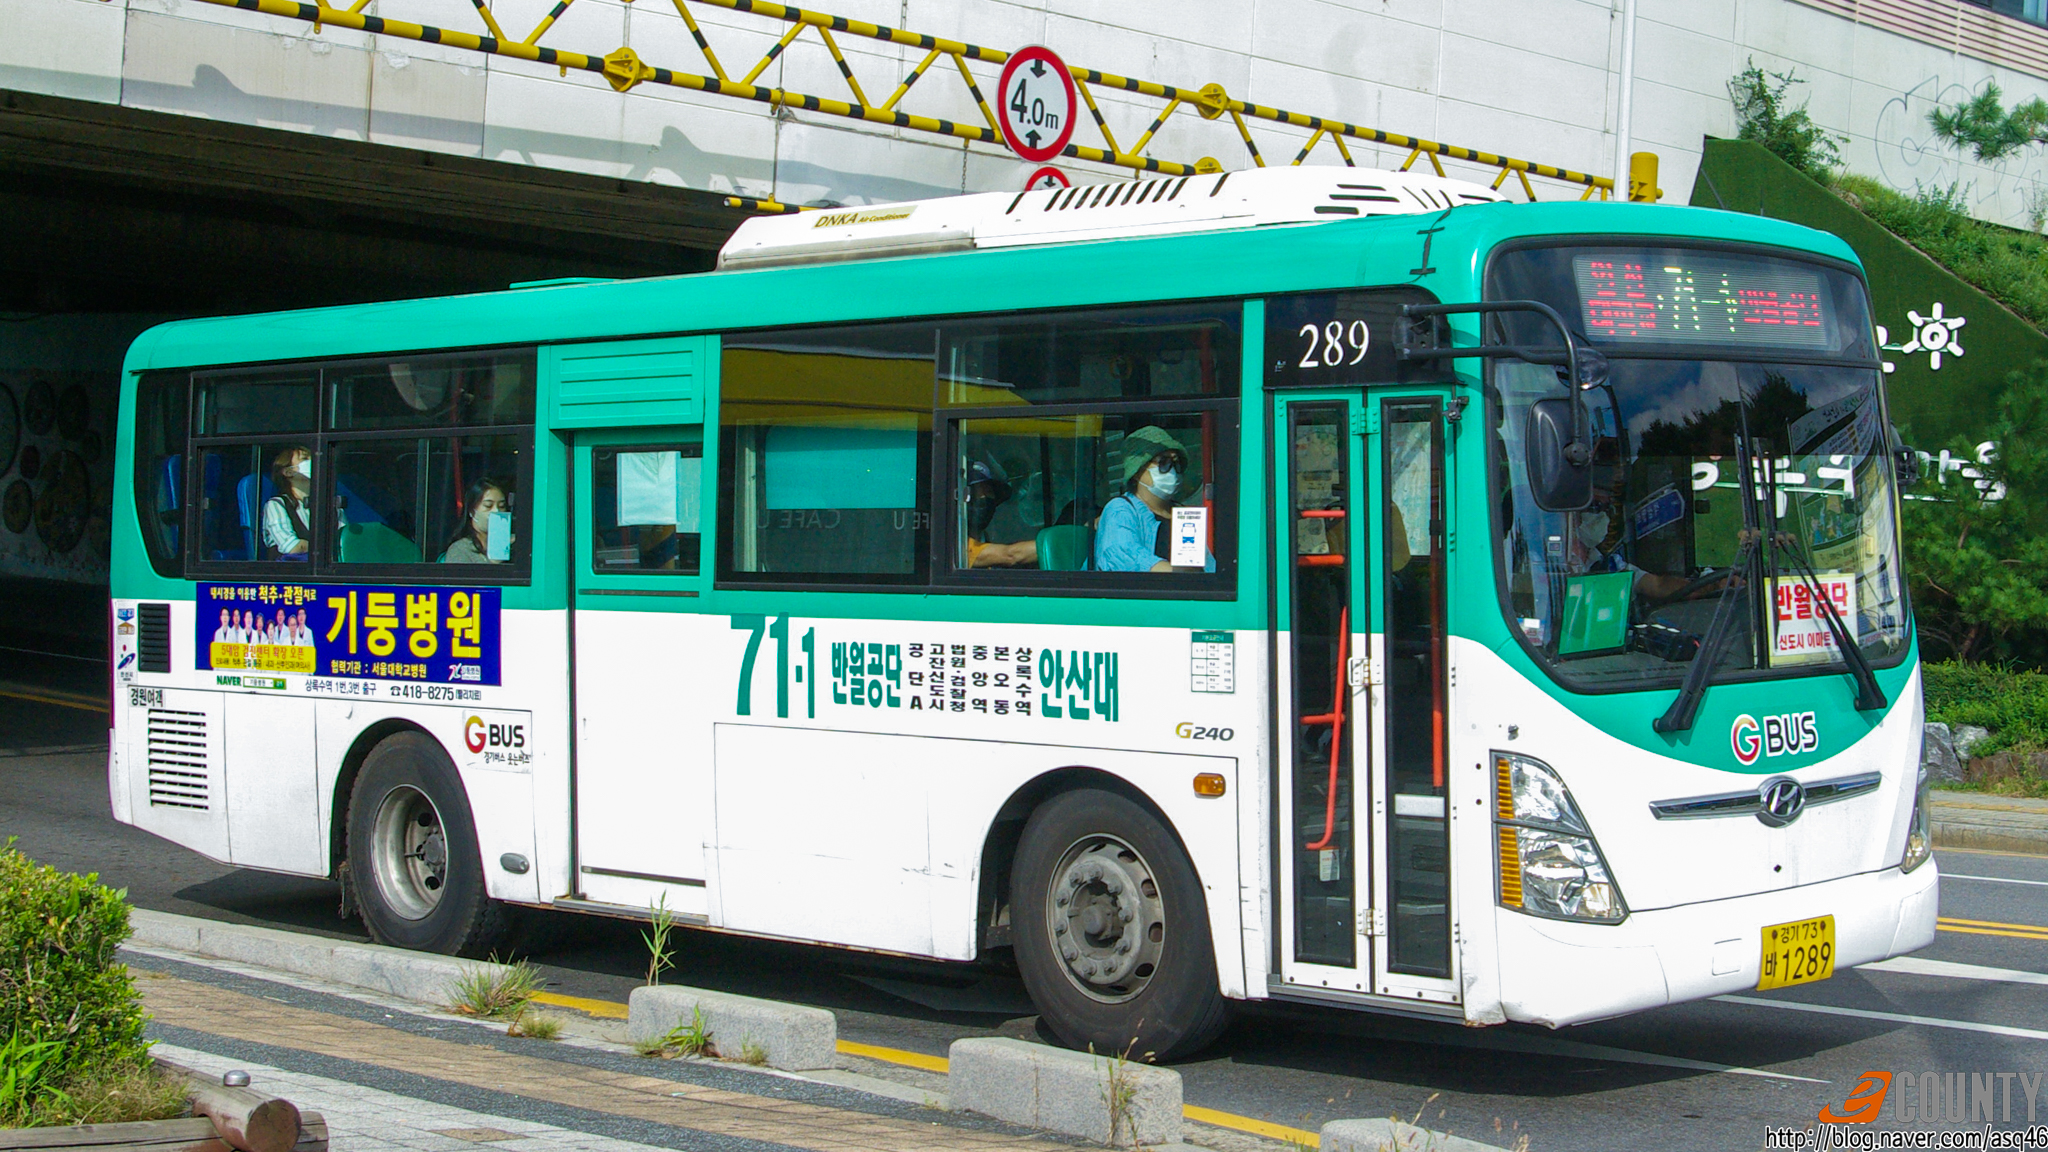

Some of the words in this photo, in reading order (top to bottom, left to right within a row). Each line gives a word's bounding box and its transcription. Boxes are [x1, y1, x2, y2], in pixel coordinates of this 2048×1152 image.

[1010, 78, 1059, 130] 4.0m
[814, 212, 859, 228] DNKA
[869, 213, 911, 222] Conditioner
[1298, 319, 1370, 368] 289
[1777, 581, 1849, 621] 반월공단
[326, 590, 481, 659] 기둥병원
[1779, 633, 1805, 651] 신도시
[1807, 631, 1831, 648] 이마트
[331, 660, 362, 675] 협력기관
[371, 662, 427, 678] 서울대학교병원
[831, 641, 903, 709] 반월공단
[216, 675, 242, 687] NAVER
[305, 679, 333, 693] 상록수역
[362, 682, 377, 696] 출구
[1038, 648, 1119, 723] 안산대
[131, 687, 164, 707] 경원여객
[1175, 721, 1235, 742] G240
[1780, 925, 1799, 944] 경기
[1802, 922, 1818, 941] 73
[1764, 951, 1778, 978] 바
[1782, 941, 1831, 982] 1289
